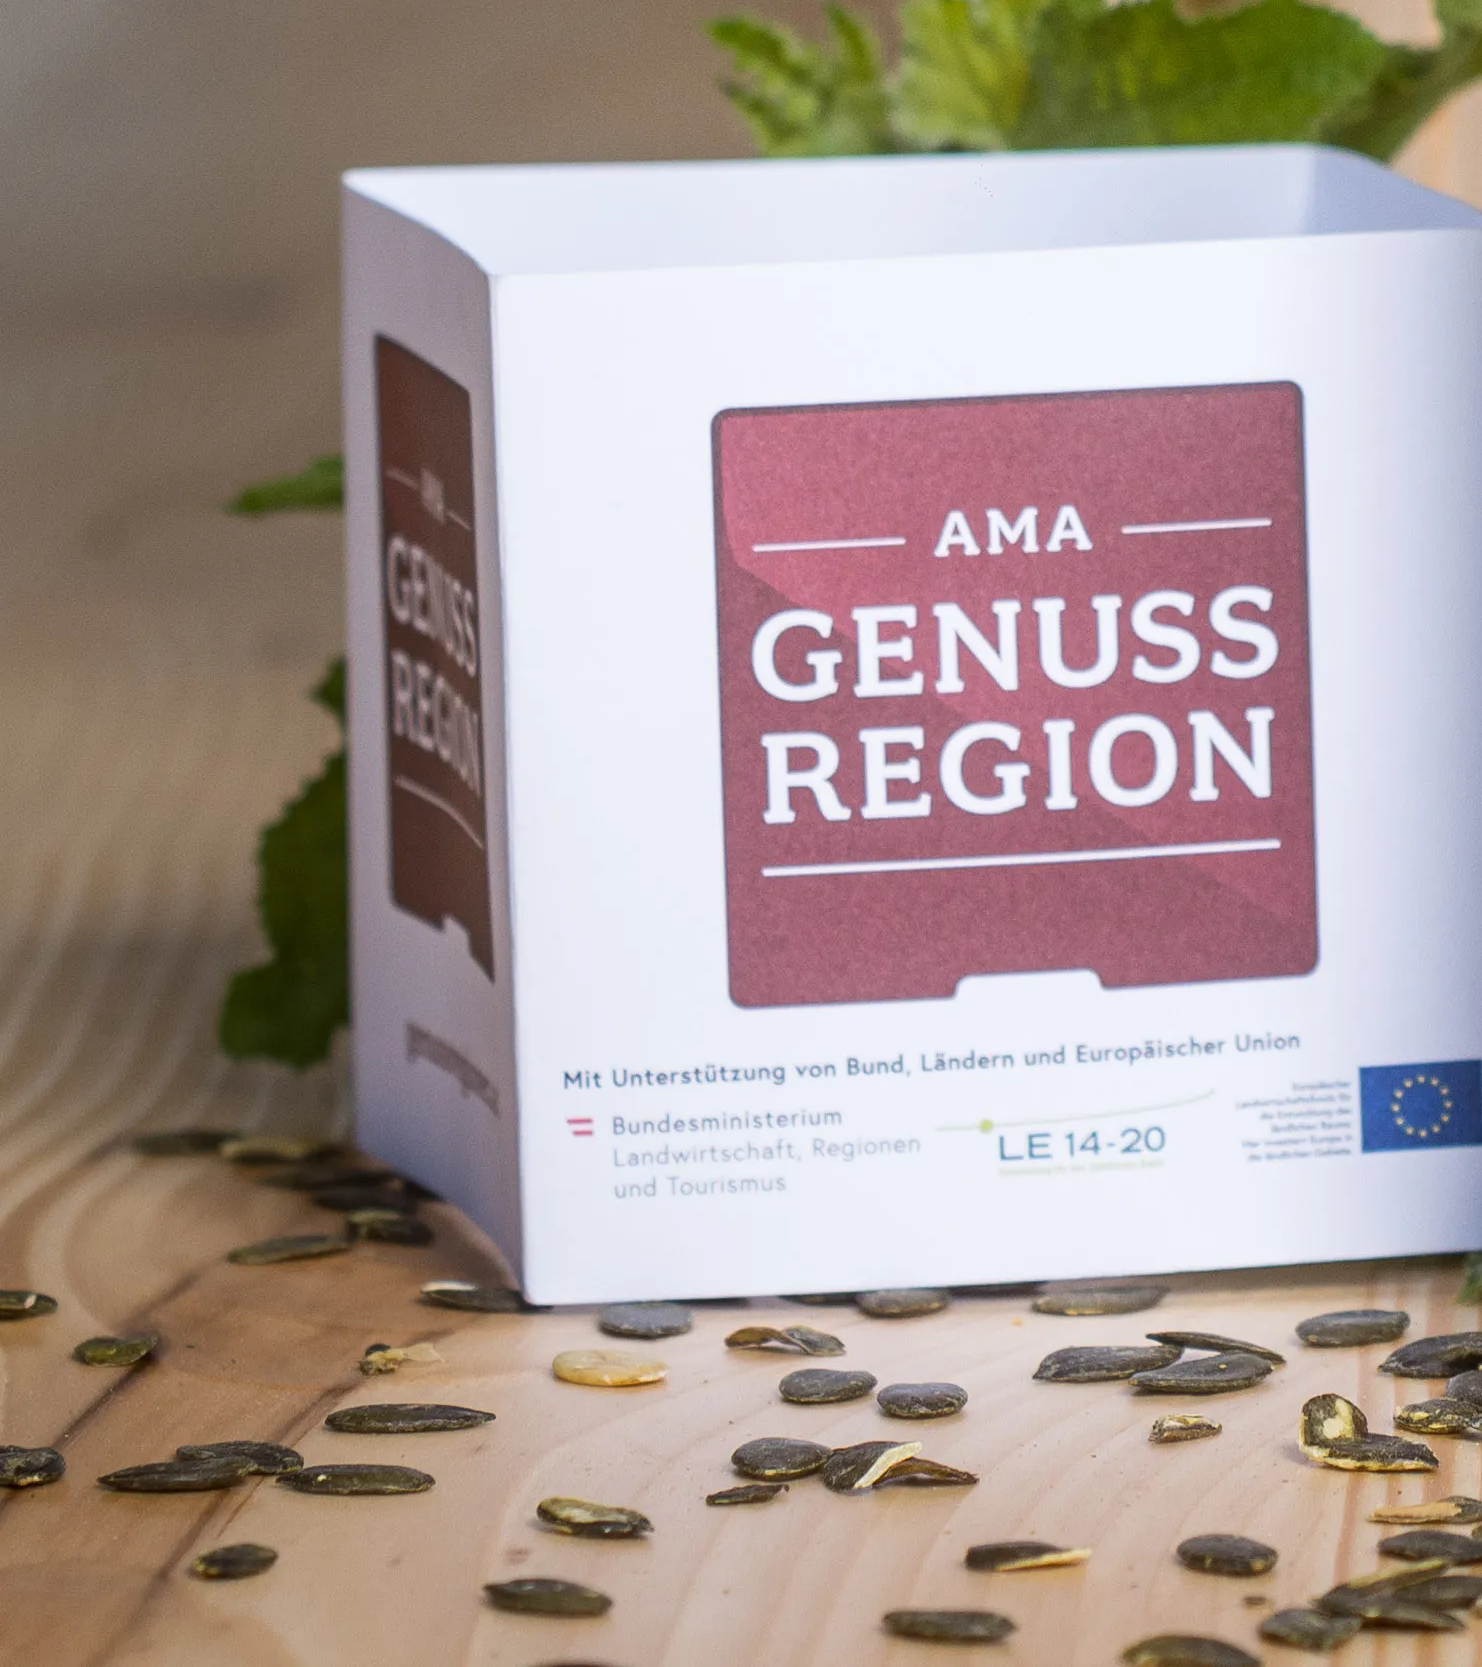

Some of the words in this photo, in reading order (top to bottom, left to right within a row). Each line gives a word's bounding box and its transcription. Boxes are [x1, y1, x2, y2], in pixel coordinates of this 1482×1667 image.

[932, 505, 1094, 559] AMA
[750, 585, 1281, 702] GENUSS
[760, 705, 1275, 826] REGION
[563, 1070, 602, 1090] Mit
[612, 1065, 786, 1088] Unterstützung
[795, 1061, 836, 1079] von
[847, 1055, 911, 1077] Bund,
[921, 1050, 1014, 1073] Ländern
[1024, 1047, 1066, 1067] und
[1076, 1036, 1226, 1065] Europäischer
[1235, 1032, 1300, 1052] Union
[612, 1109, 843, 1135] Bundesministerium
[999, 1133, 1053, 1161] LE
[1065, 1126, 1166, 1158] 14-20
[613, 1139, 802, 1168] Landwirtschaft,
[812, 1135, 922, 1161] Regionen
[614, 1178, 657, 1199] und
[667, 1174, 787, 1196] Tourismus
